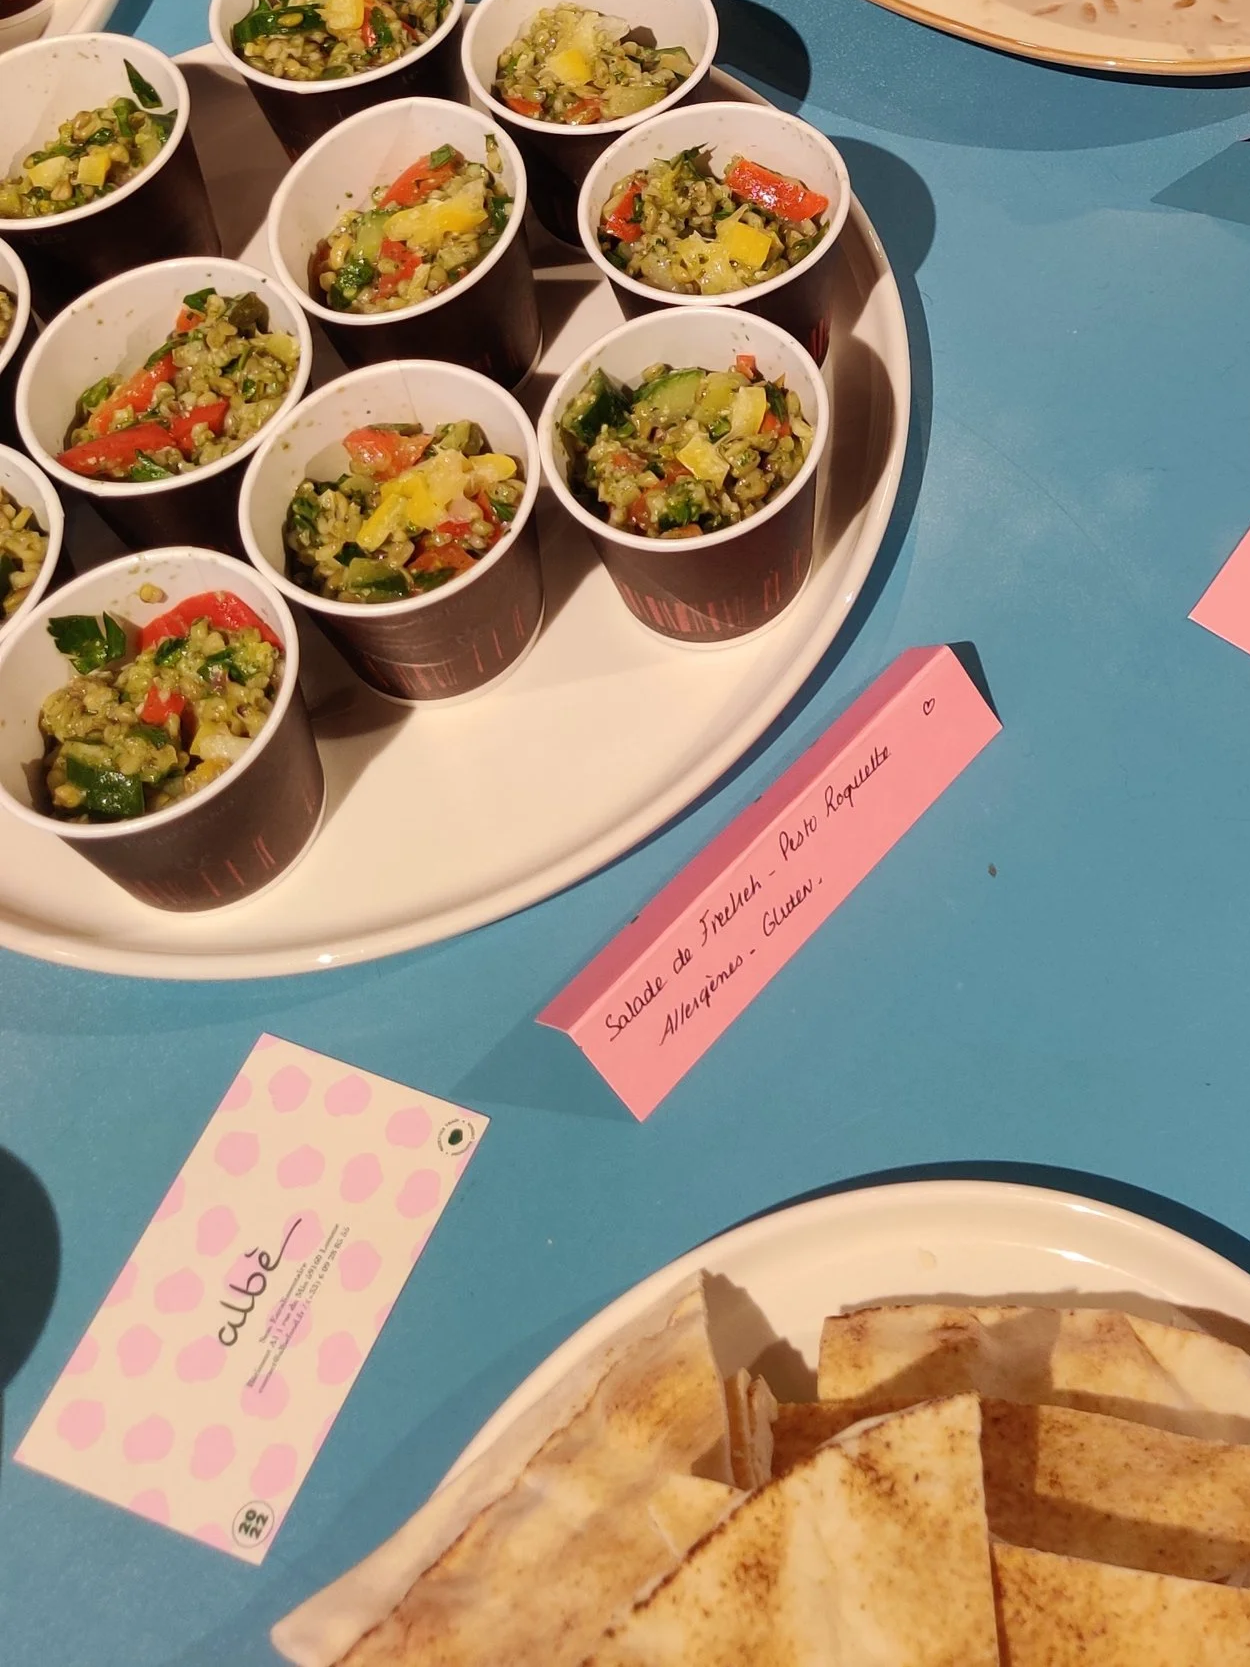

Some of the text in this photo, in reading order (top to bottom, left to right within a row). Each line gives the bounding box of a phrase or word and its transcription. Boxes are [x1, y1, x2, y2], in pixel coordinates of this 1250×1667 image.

[605, 976, 668, 1043] Salade
[672, 947, 694, 975] de
[778, 815, 818, 862] Pesto
[825, 746, 890, 818] Roquette
[658, 954, 744, 1047] Allergènes
[239, 1509, 257, 1535] 20
[250, 1513, 269, 1540] 22
